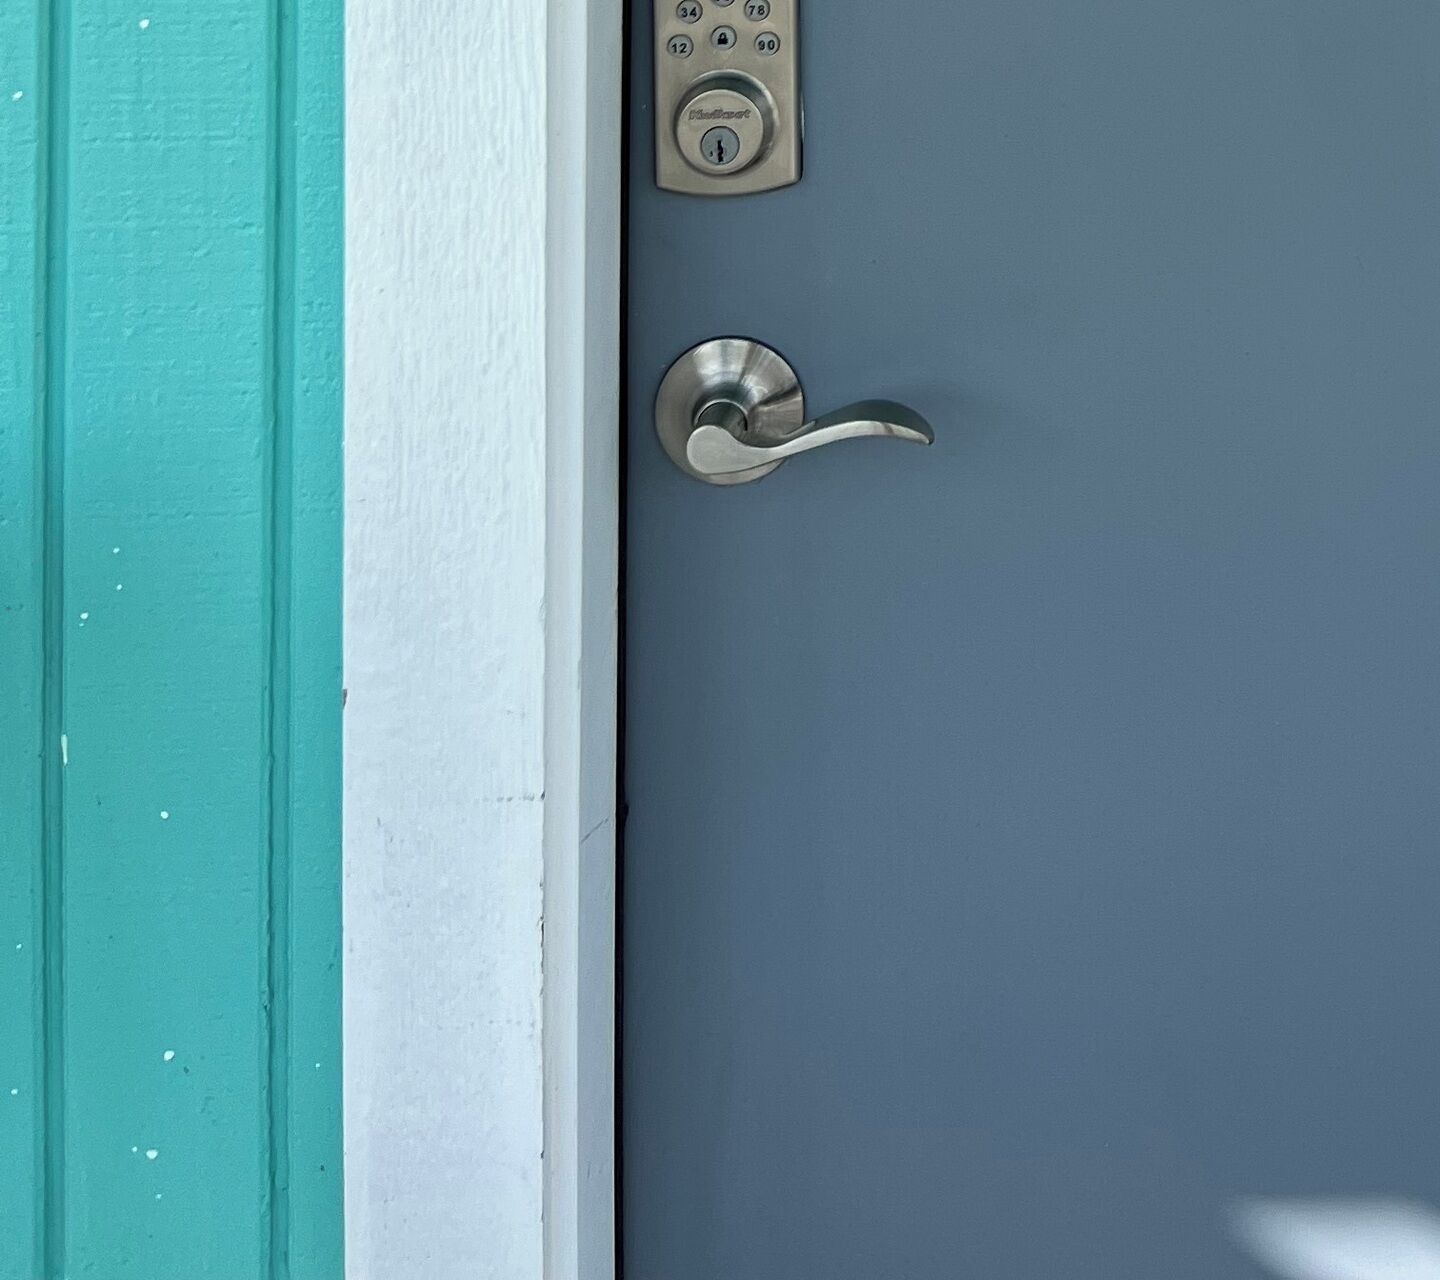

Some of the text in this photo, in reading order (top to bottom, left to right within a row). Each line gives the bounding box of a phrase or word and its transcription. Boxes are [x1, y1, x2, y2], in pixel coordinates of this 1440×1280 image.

[681, 6, 697, 18] 34
[748, 4, 766, 16] 78
[671, 42, 687, 54] 12
[757, 39, 775, 51] 90
